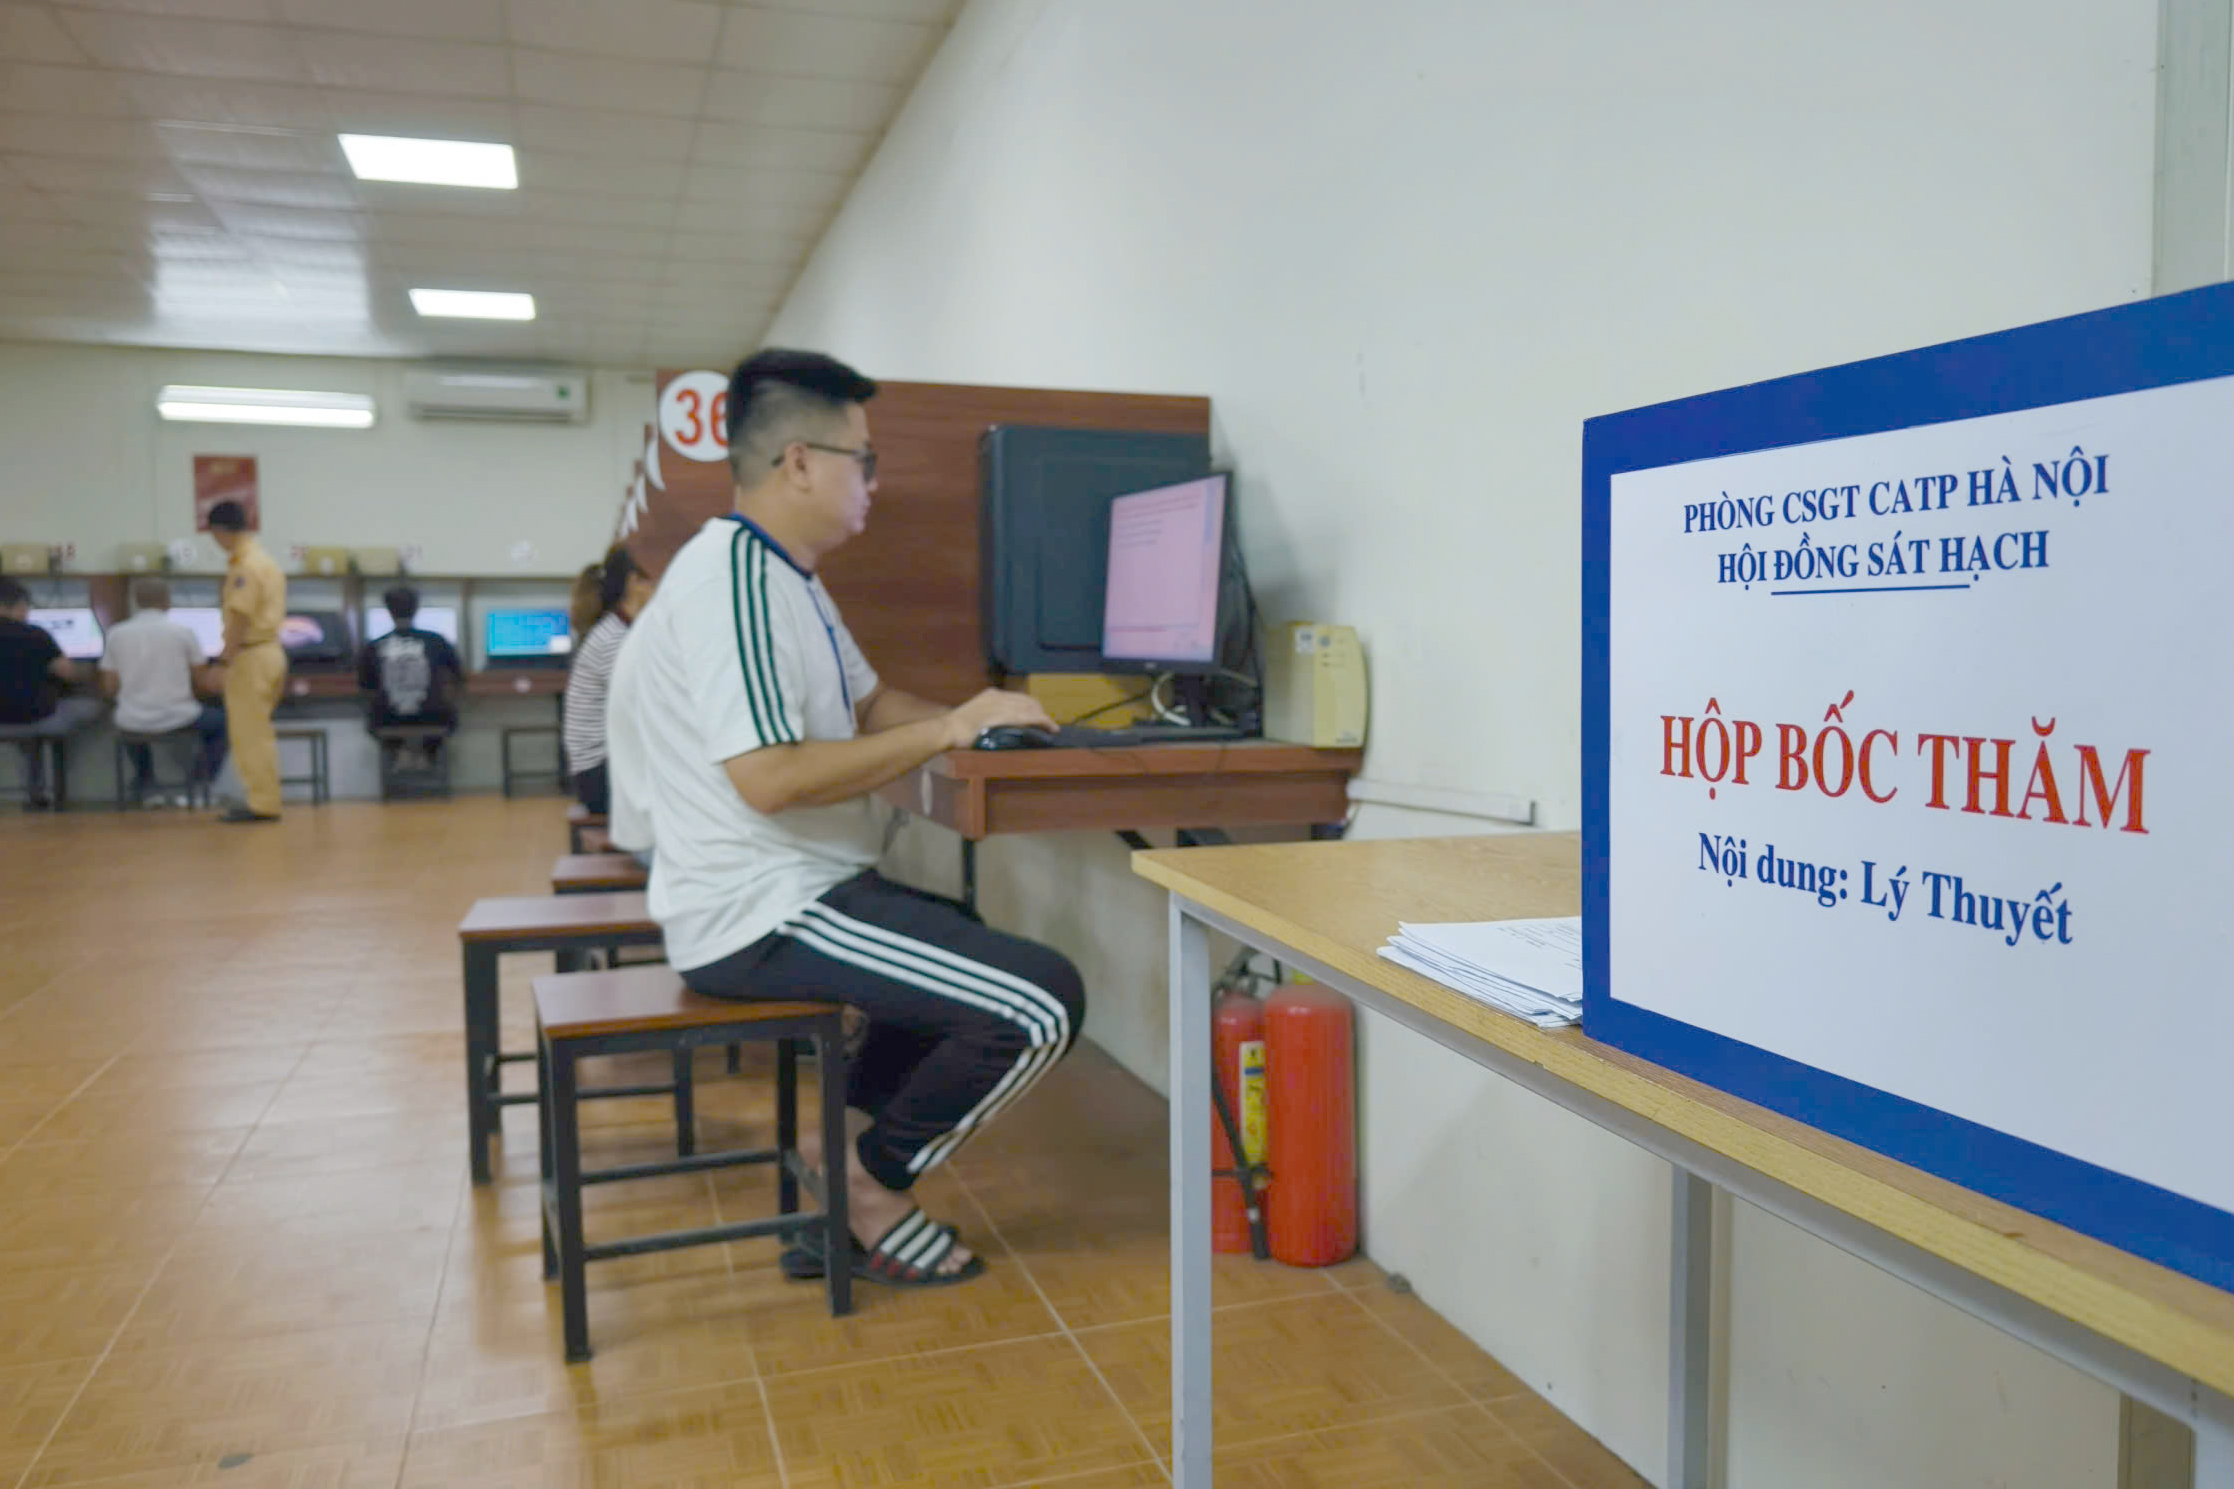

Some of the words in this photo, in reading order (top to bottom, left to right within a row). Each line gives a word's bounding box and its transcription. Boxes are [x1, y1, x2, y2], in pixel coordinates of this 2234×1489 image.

[1684, 491, 1775, 534] PHÒNG
[1782, 484, 1861, 525] CSGT
[1868, 473, 1959, 517] CATP
[1966, 455, 2022, 507] HÀ
[2032, 445, 2110, 508] NỘI
[1718, 543, 1768, 590] HỘI
[1773, 532, 1860, 583] ĐỒNG
[1867, 529, 1931, 578] SÁT
[1939, 529, 2050, 582] HẠCH
[1660, 697, 1762, 800] HỘP
[1775, 690, 1898, 804] BỐC
[1917, 716, 2151, 834] THĂM
[1698, 832, 1748, 888] Nội
[1756, 843, 1849, 908] dung:
[1860, 861, 1910, 922] Lý
[1922, 870, 2073, 947] Thuyết
